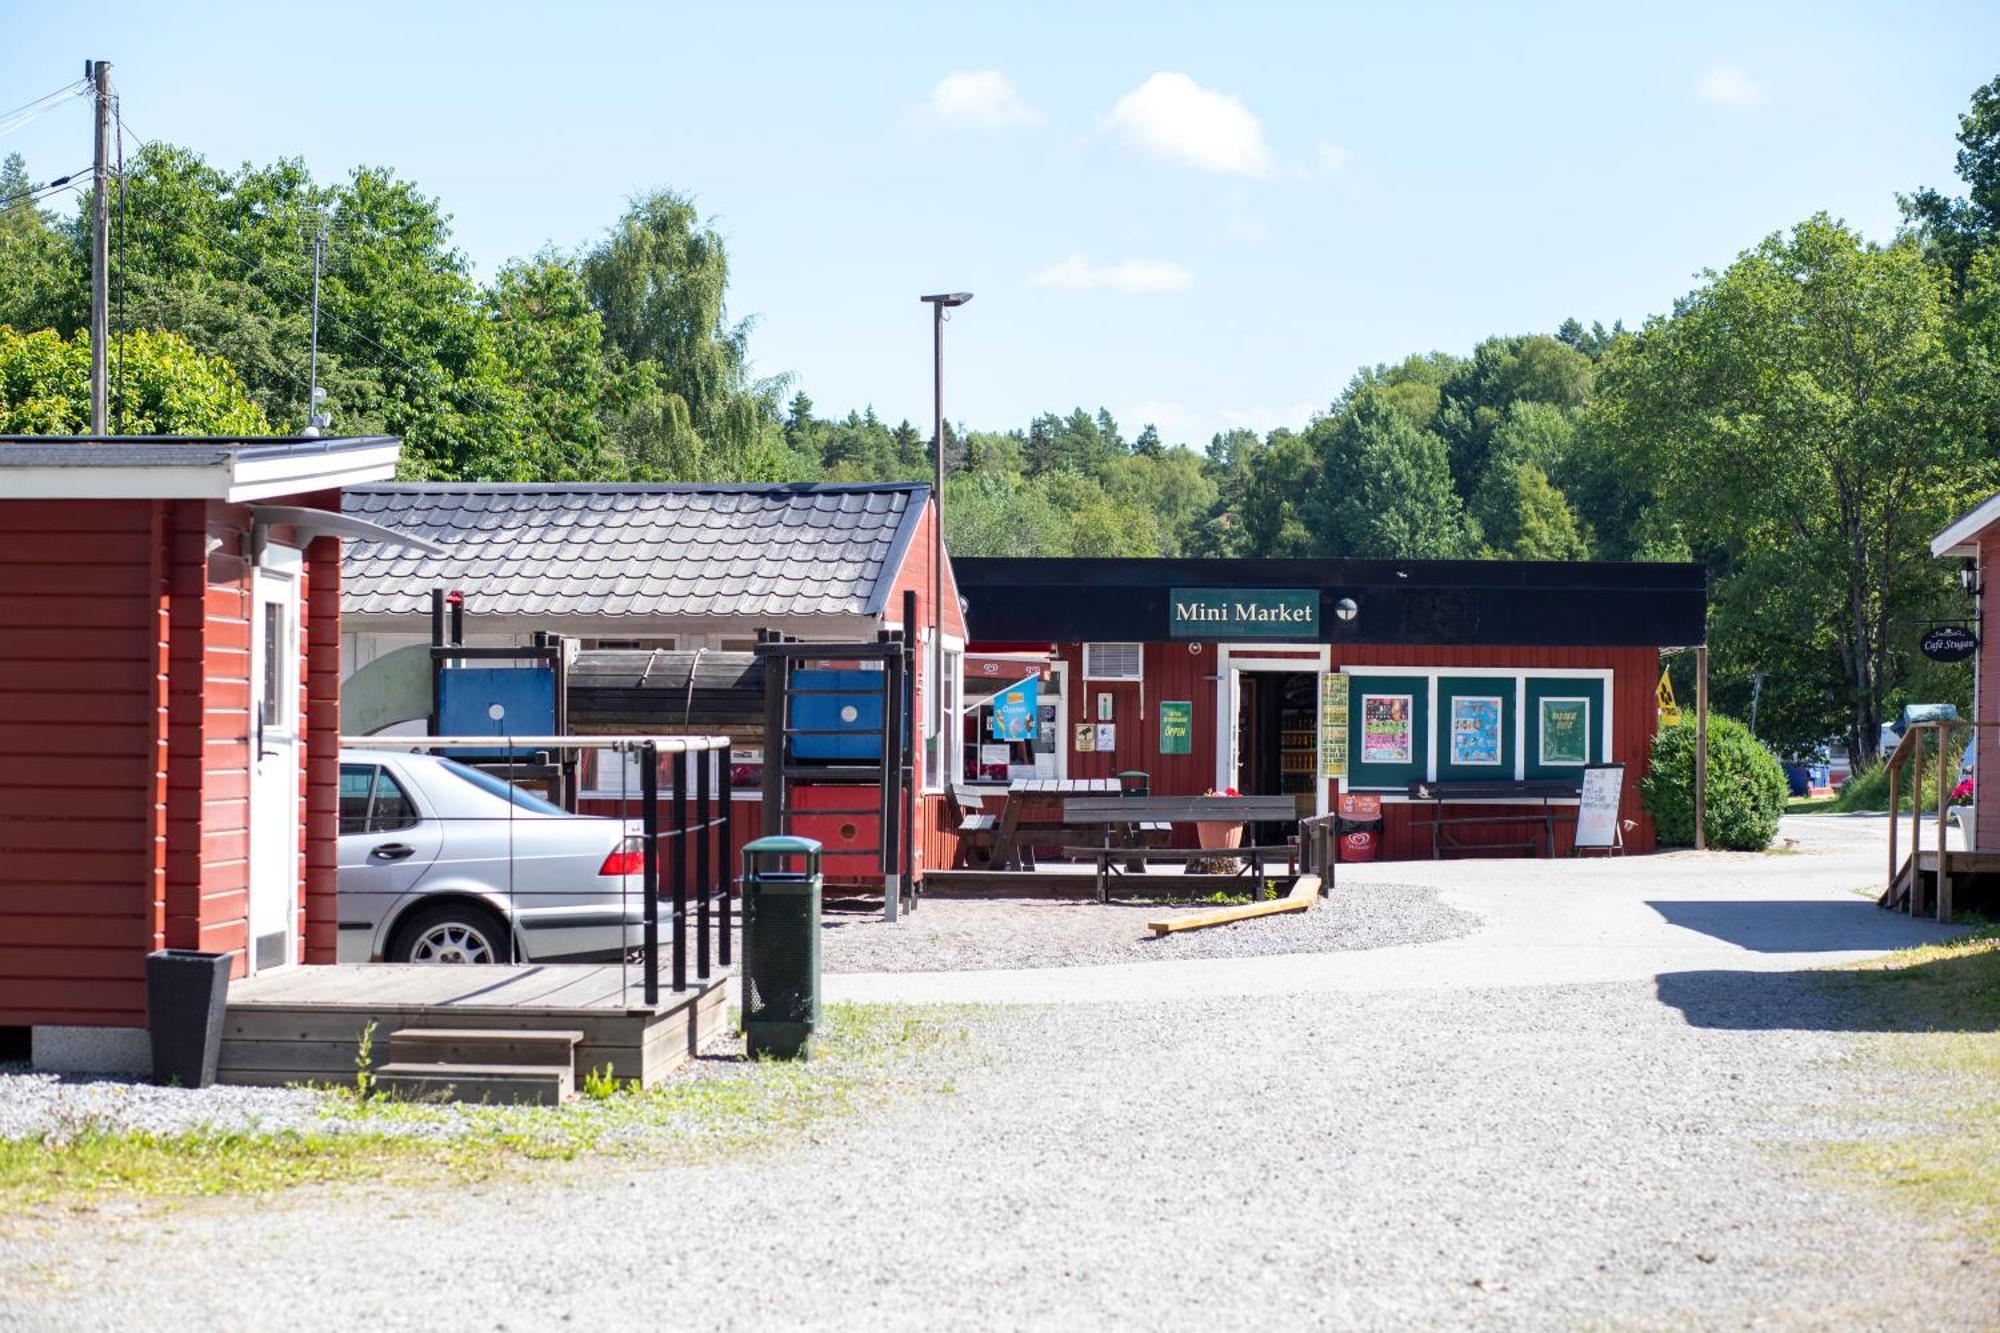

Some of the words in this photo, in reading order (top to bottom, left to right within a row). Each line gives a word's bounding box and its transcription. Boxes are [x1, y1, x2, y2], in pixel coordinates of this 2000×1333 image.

[1176, 603, 1228, 621] Mini
[1234, 603, 1313, 621] Market
[1944, 640, 1974, 651] Stugan
